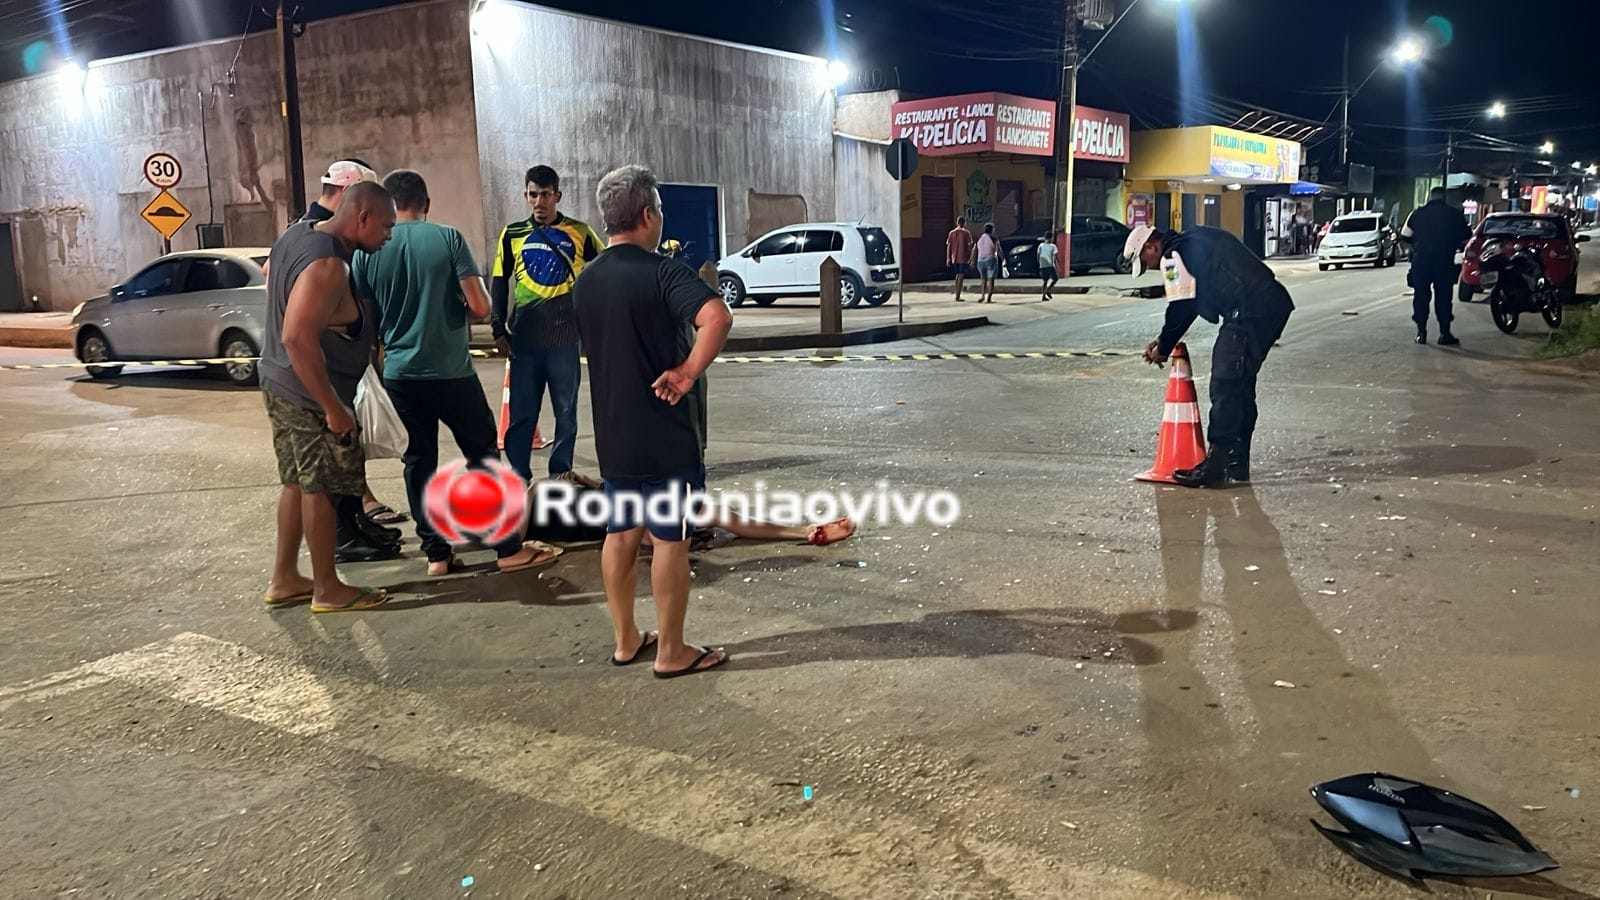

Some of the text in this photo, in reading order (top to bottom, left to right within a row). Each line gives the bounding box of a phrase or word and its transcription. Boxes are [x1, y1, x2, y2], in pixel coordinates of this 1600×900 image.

[895, 106, 959, 125] RESTAURANTE
[997, 104, 1051, 128] RESTAURANTE
[1002, 126, 1049, 148] LANCHONETE
[1073, 117, 1124, 157] I-DELÍCIA
[150, 160, 175, 177] 30
